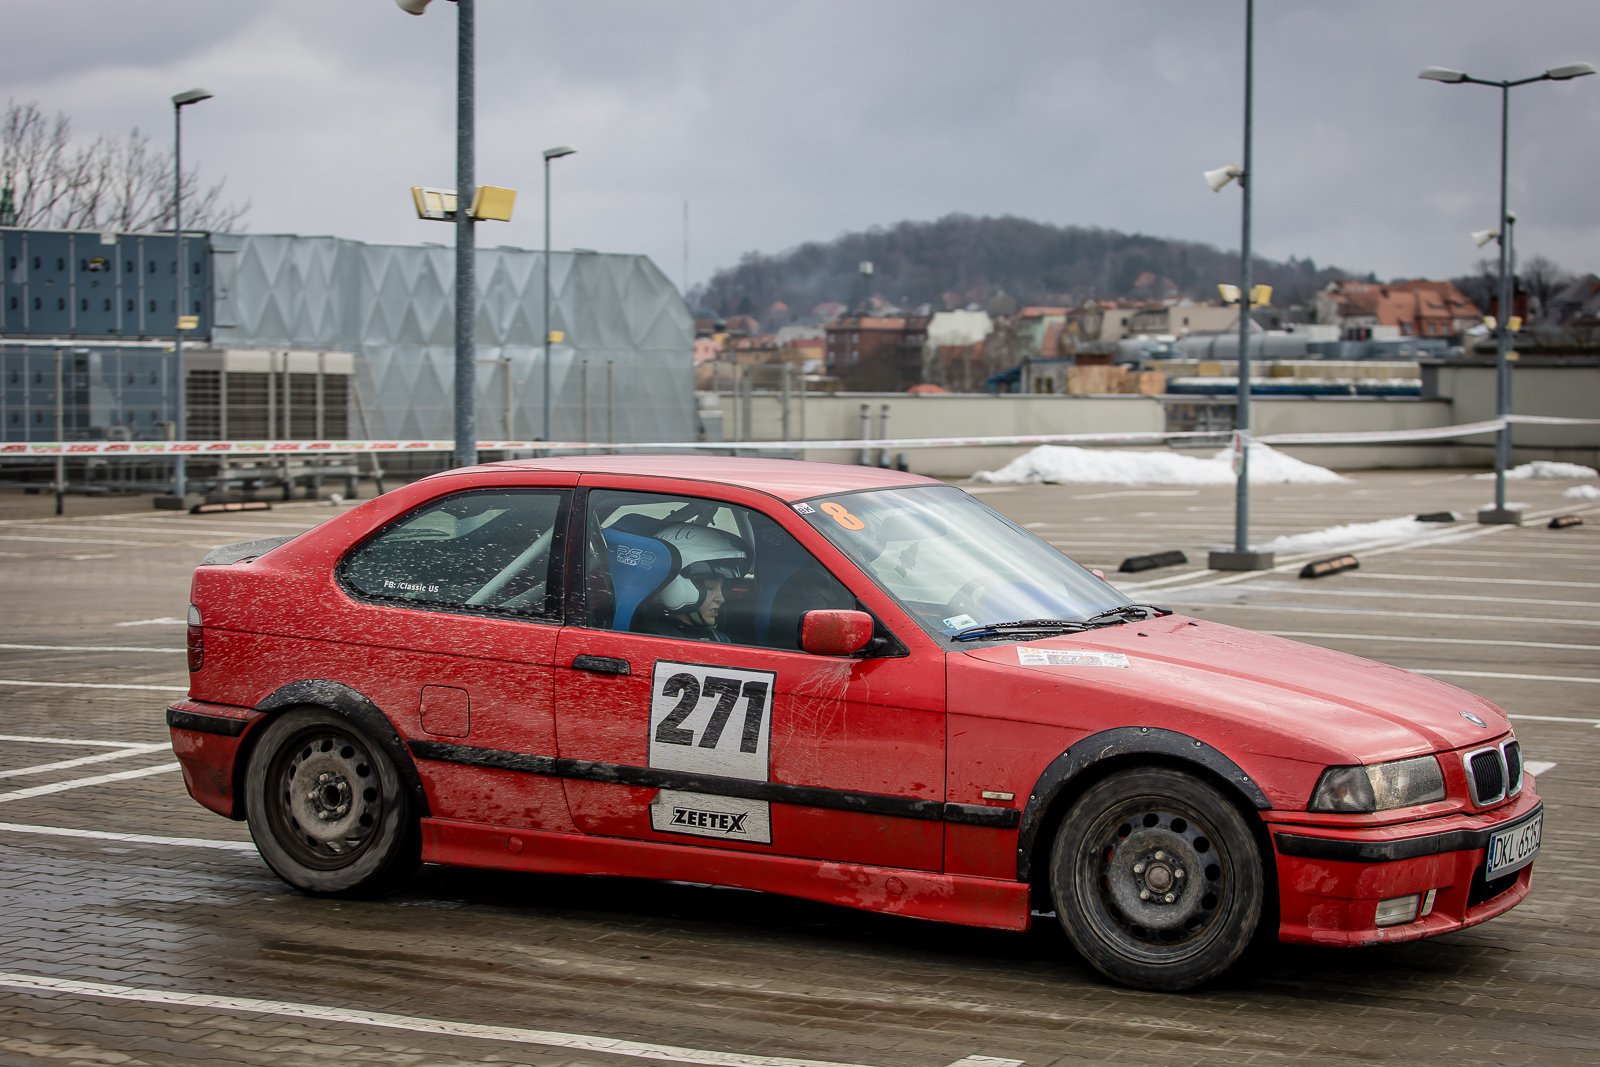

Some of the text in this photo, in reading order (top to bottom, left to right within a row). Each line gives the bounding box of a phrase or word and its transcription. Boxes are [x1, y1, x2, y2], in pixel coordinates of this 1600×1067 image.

[820, 502, 864, 531] 8
[384, 580, 396, 588] FB:
[655, 673, 769, 754] 271
[671, 807, 748, 834] ZEETEX
[1493, 834, 1515, 868] DKL
